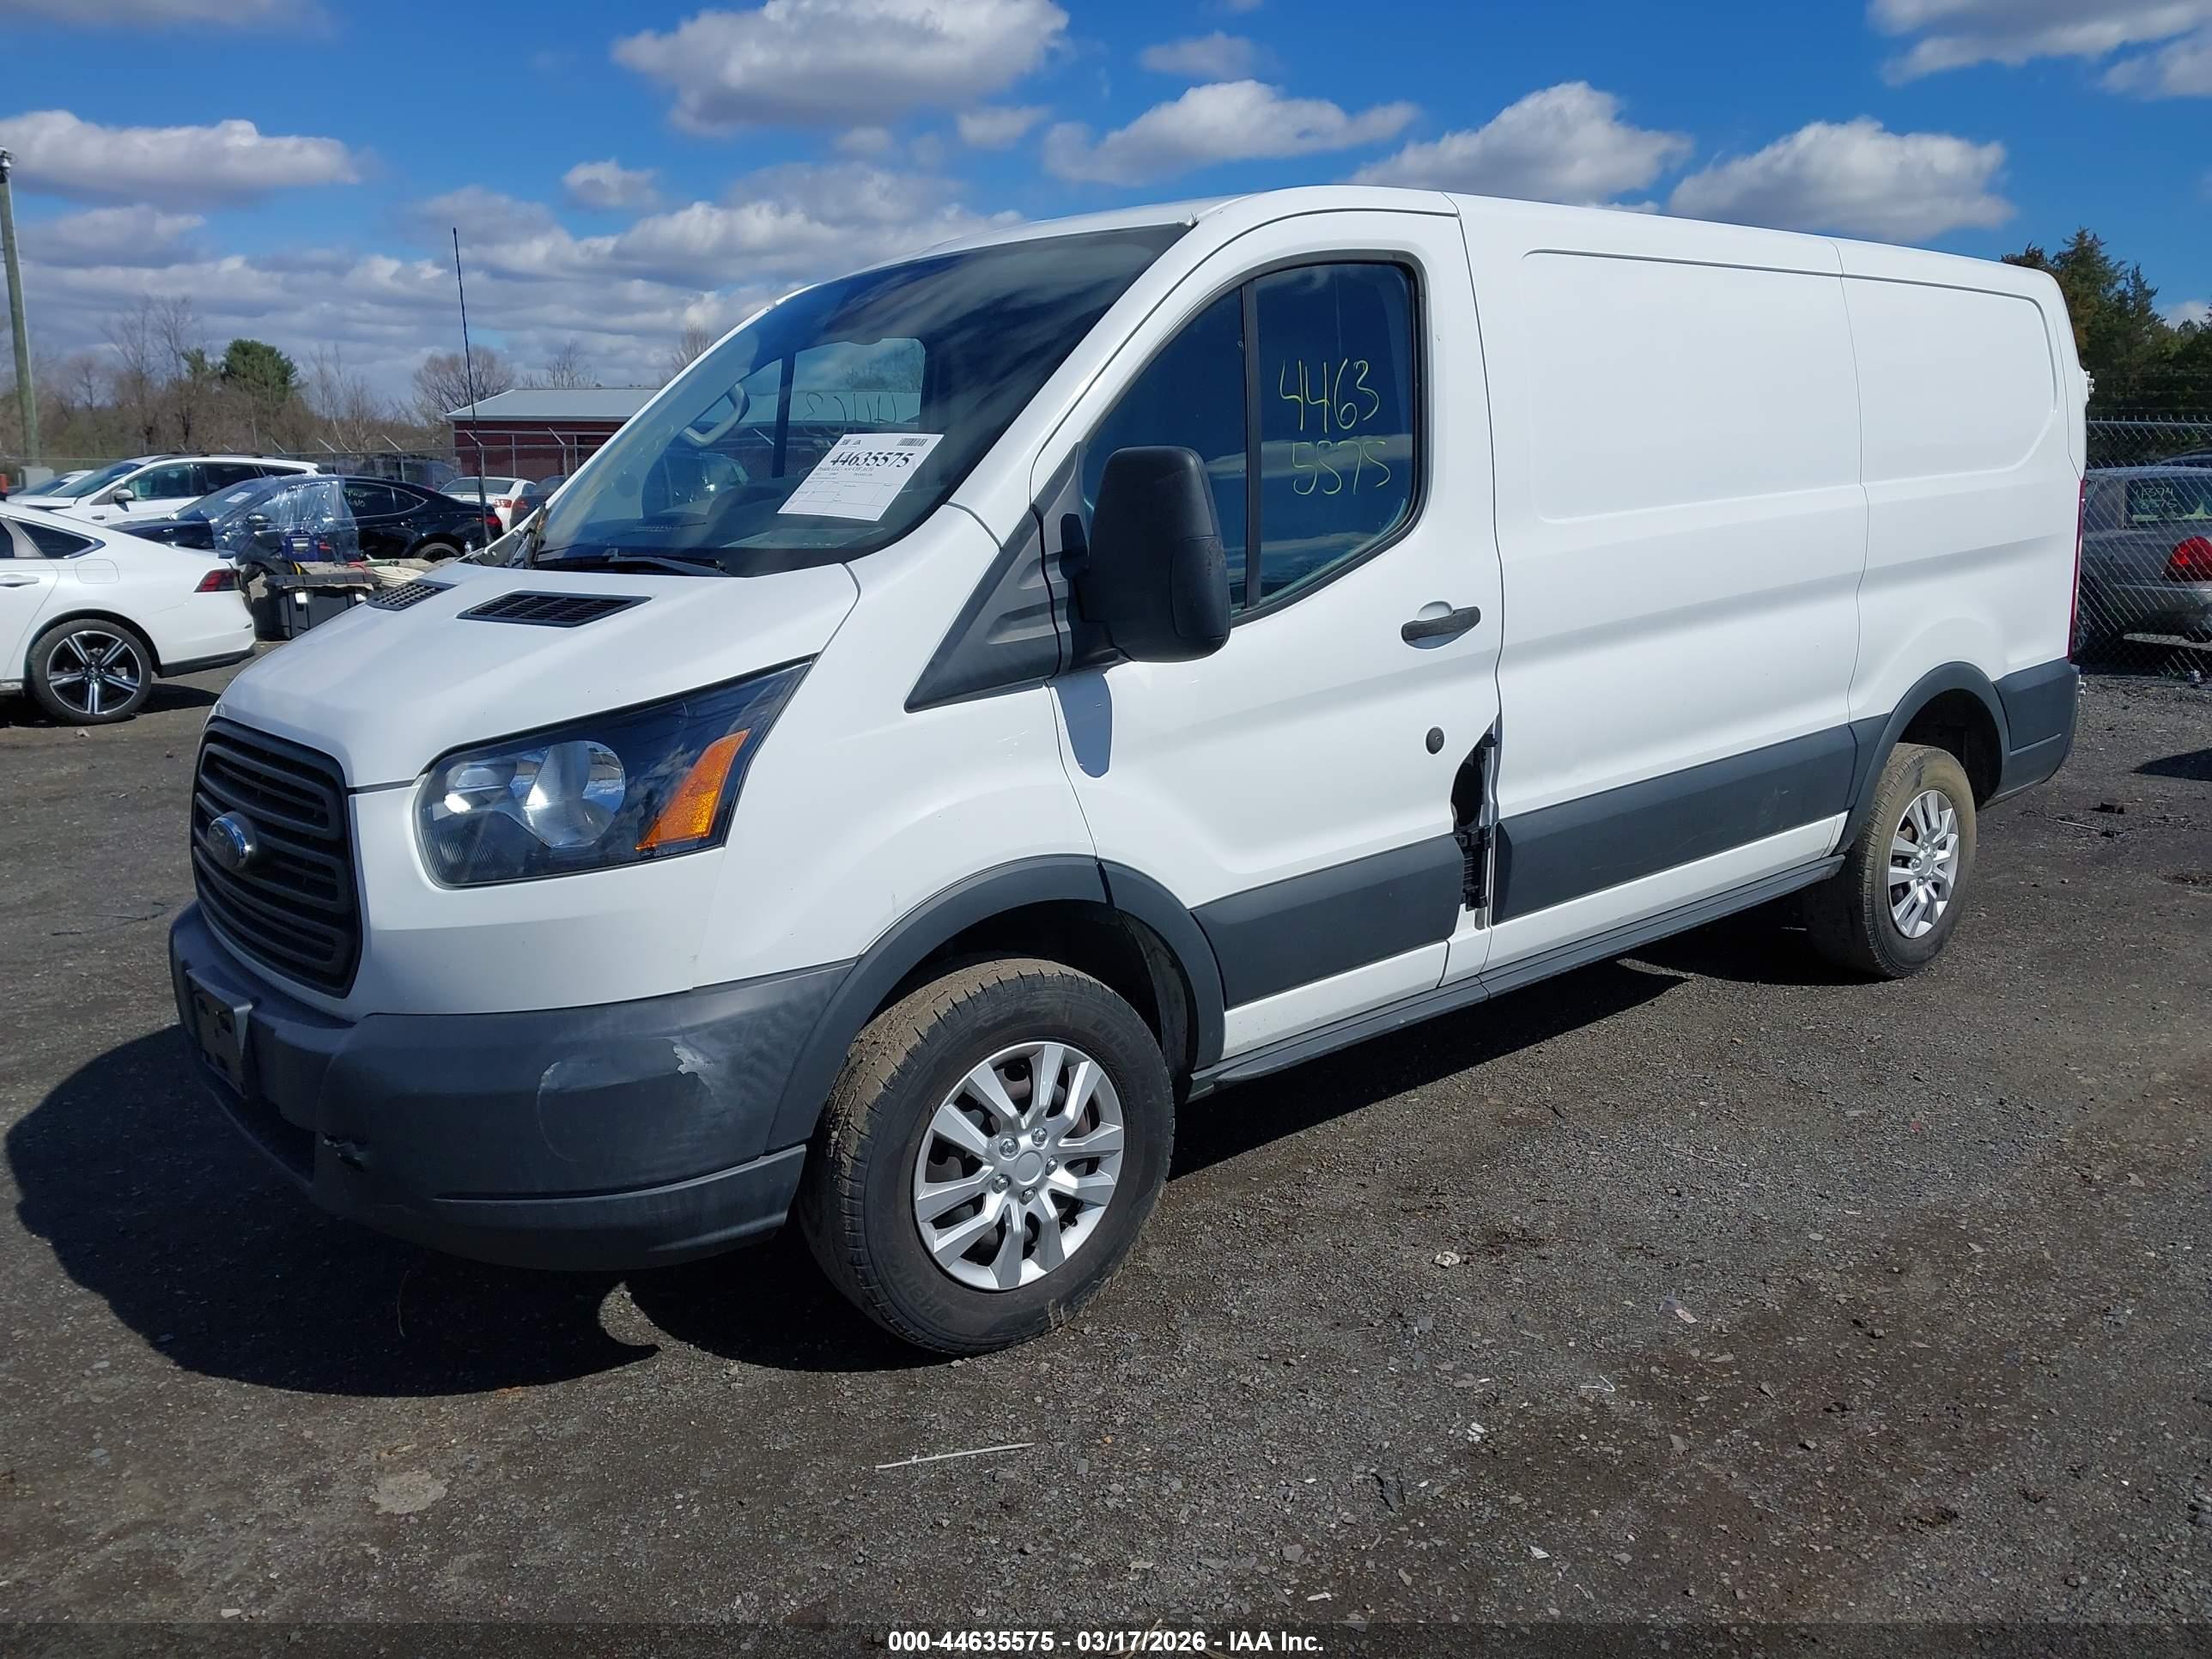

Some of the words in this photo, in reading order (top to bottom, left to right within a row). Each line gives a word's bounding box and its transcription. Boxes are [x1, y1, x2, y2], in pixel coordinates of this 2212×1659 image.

[1279, 358, 1380, 434] 4463
[830, 451, 915, 468] 44635575
[1291, 440, 1391, 495] 5575
